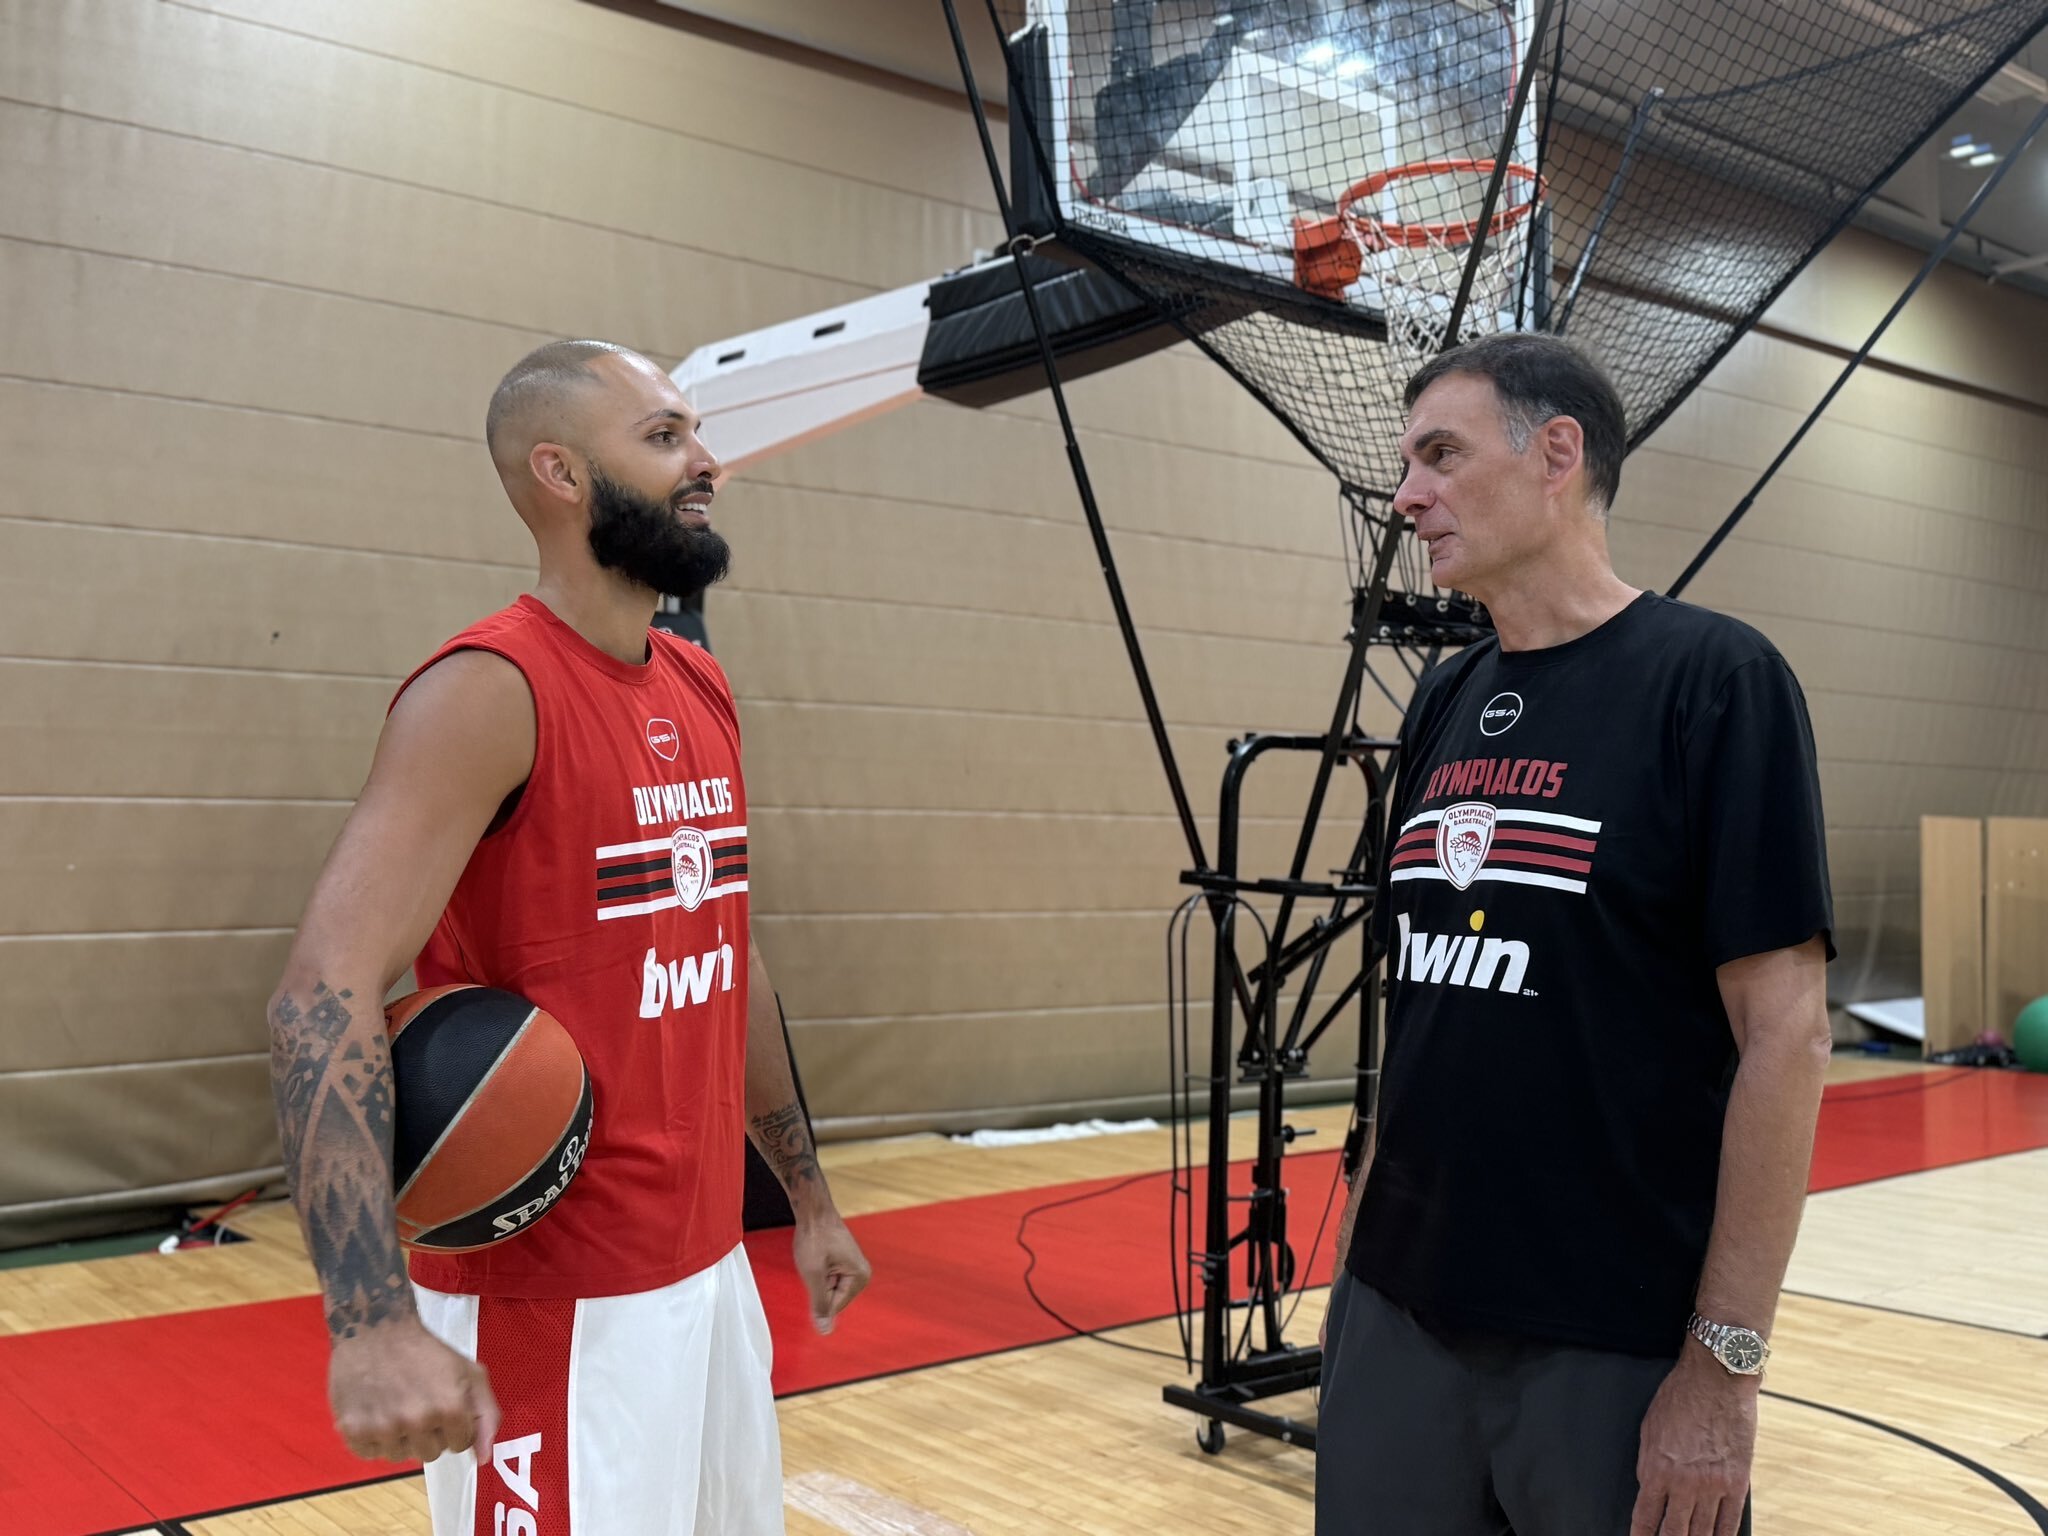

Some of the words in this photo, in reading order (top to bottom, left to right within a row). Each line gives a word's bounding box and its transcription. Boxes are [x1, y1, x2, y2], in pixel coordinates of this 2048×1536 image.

[1484, 709, 1517, 718] GSA
[632, 777, 733, 826] OLYMPIACOS
[1448, 808, 1494, 821] OLYMPIACOS
